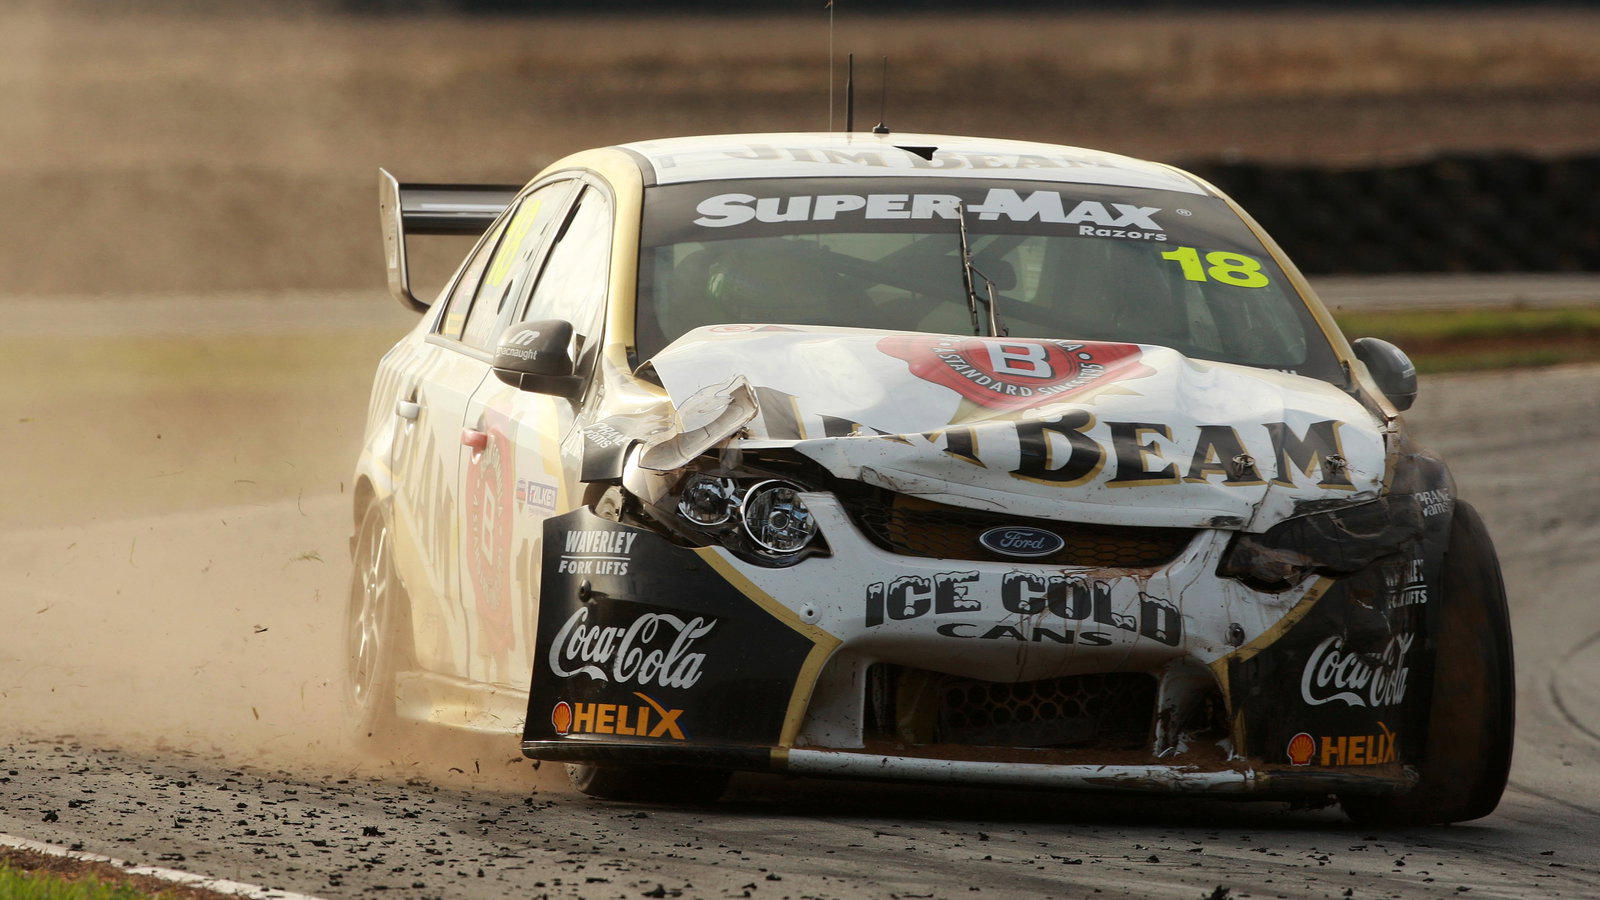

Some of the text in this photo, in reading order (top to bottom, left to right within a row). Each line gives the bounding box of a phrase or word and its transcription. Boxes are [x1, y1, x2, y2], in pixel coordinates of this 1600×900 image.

[723, 144, 888, 167] JIM
[1079, 225, 1168, 242] Razors
[1161, 247, 1269, 289] 18
[939, 352, 1033, 398] STANDARD
[981, 340, 1056, 379] B
[1007, 407, 1357, 491] BEAM
[564, 530, 637, 555] WAVERLEY
[999, 530, 1046, 550] Ford
[558, 559, 629, 576] FORK LIFTS
[865, 570, 1182, 648] ICE COLD
[548, 606, 718, 690] Coca-Cola
[936, 622, 1113, 647] CANS
[573, 692, 688, 740] HELIX
[1320, 720, 1397, 767] HELIX
